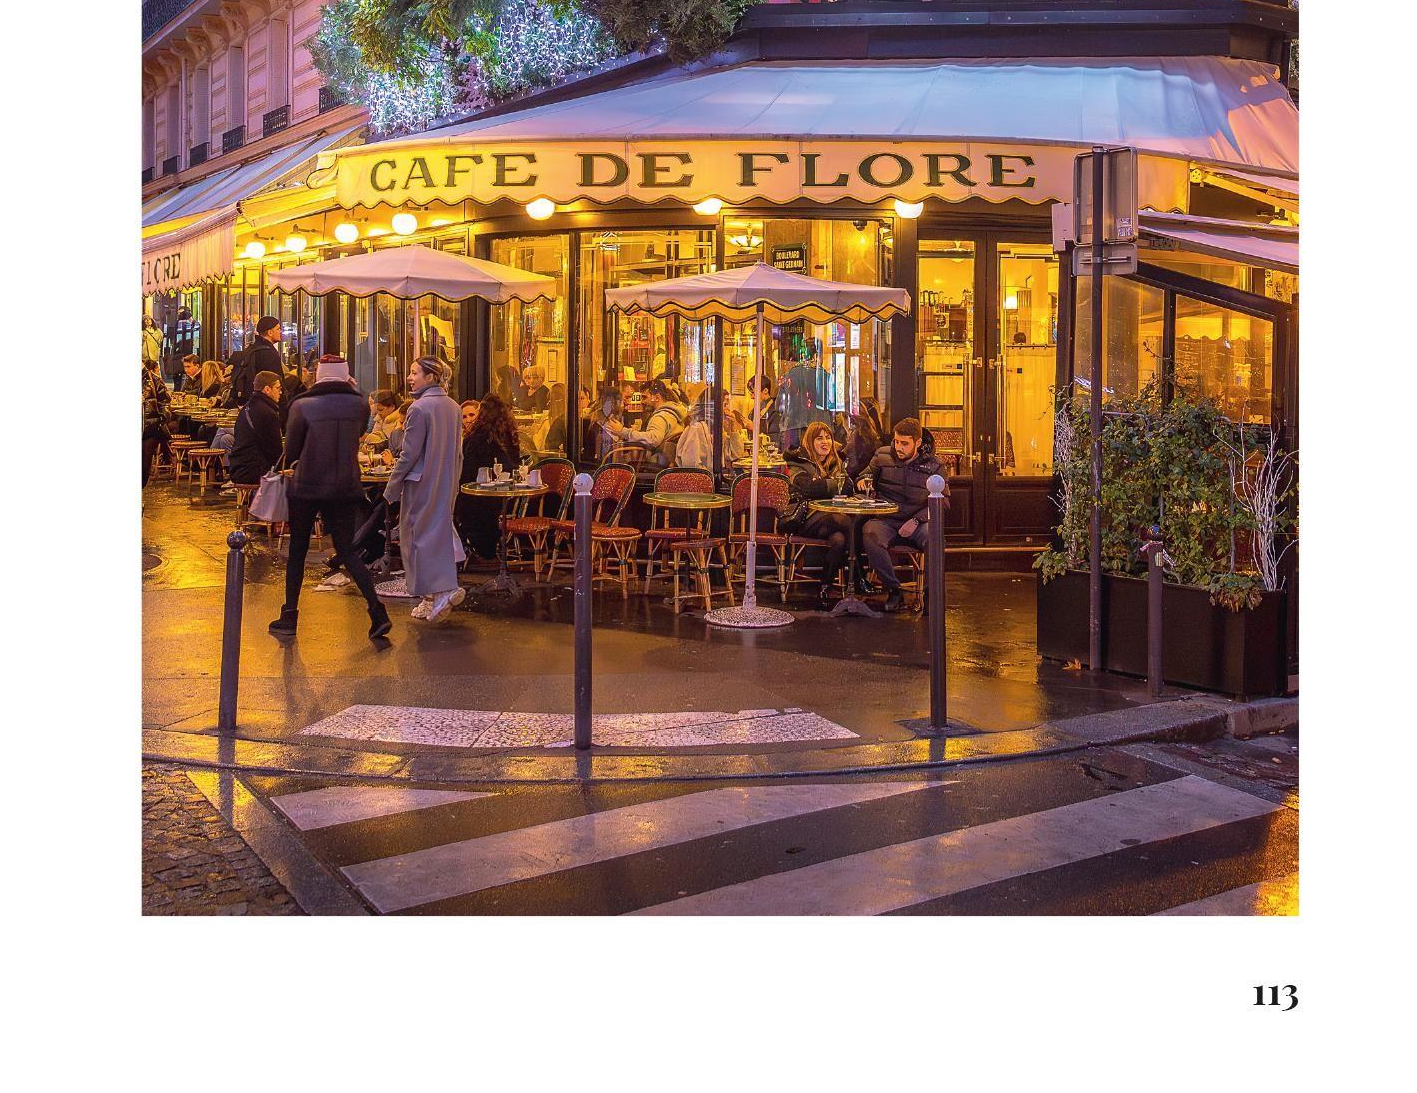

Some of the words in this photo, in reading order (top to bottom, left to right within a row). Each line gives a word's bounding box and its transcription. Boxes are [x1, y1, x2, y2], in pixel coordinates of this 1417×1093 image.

[370, 152, 539, 192] CAFE
[576, 152, 695, 189] DE
[736, 151, 1037, 189] FLORE
[1252, 984, 1299, 1012] 113
